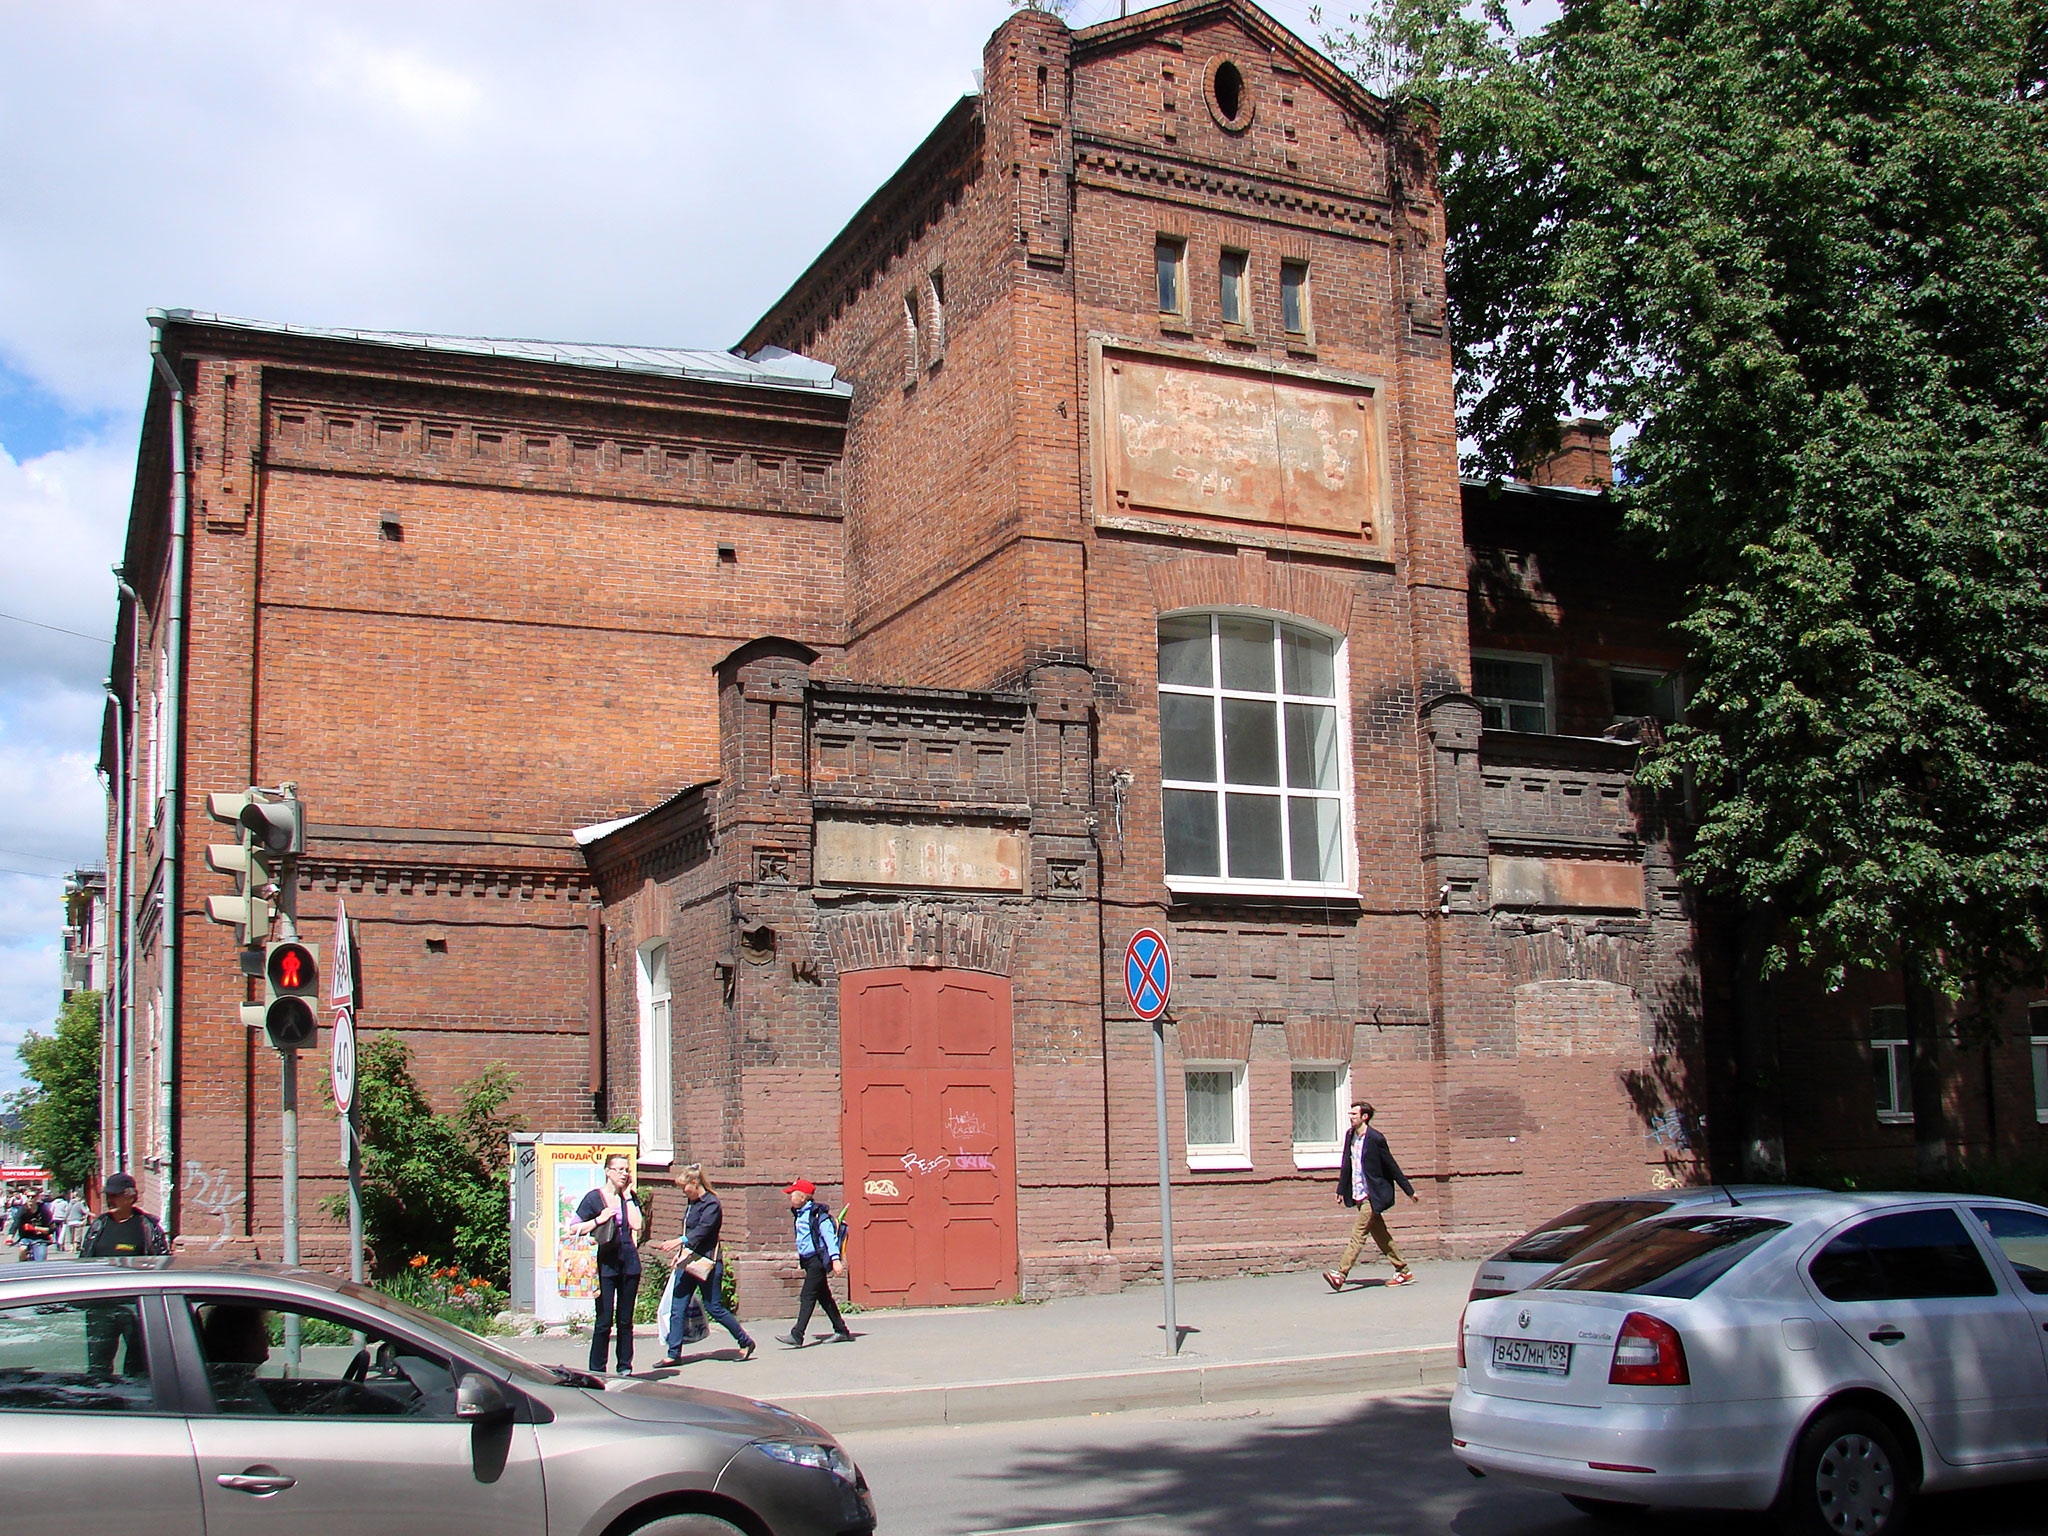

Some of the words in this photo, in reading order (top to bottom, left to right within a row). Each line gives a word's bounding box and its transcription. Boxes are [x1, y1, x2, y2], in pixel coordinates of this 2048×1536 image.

[336, 1042, 349, 1081] 40
[551, 1152, 589, 1161] ПОГОДА
[1546, 1344, 1566, 1360] 159
